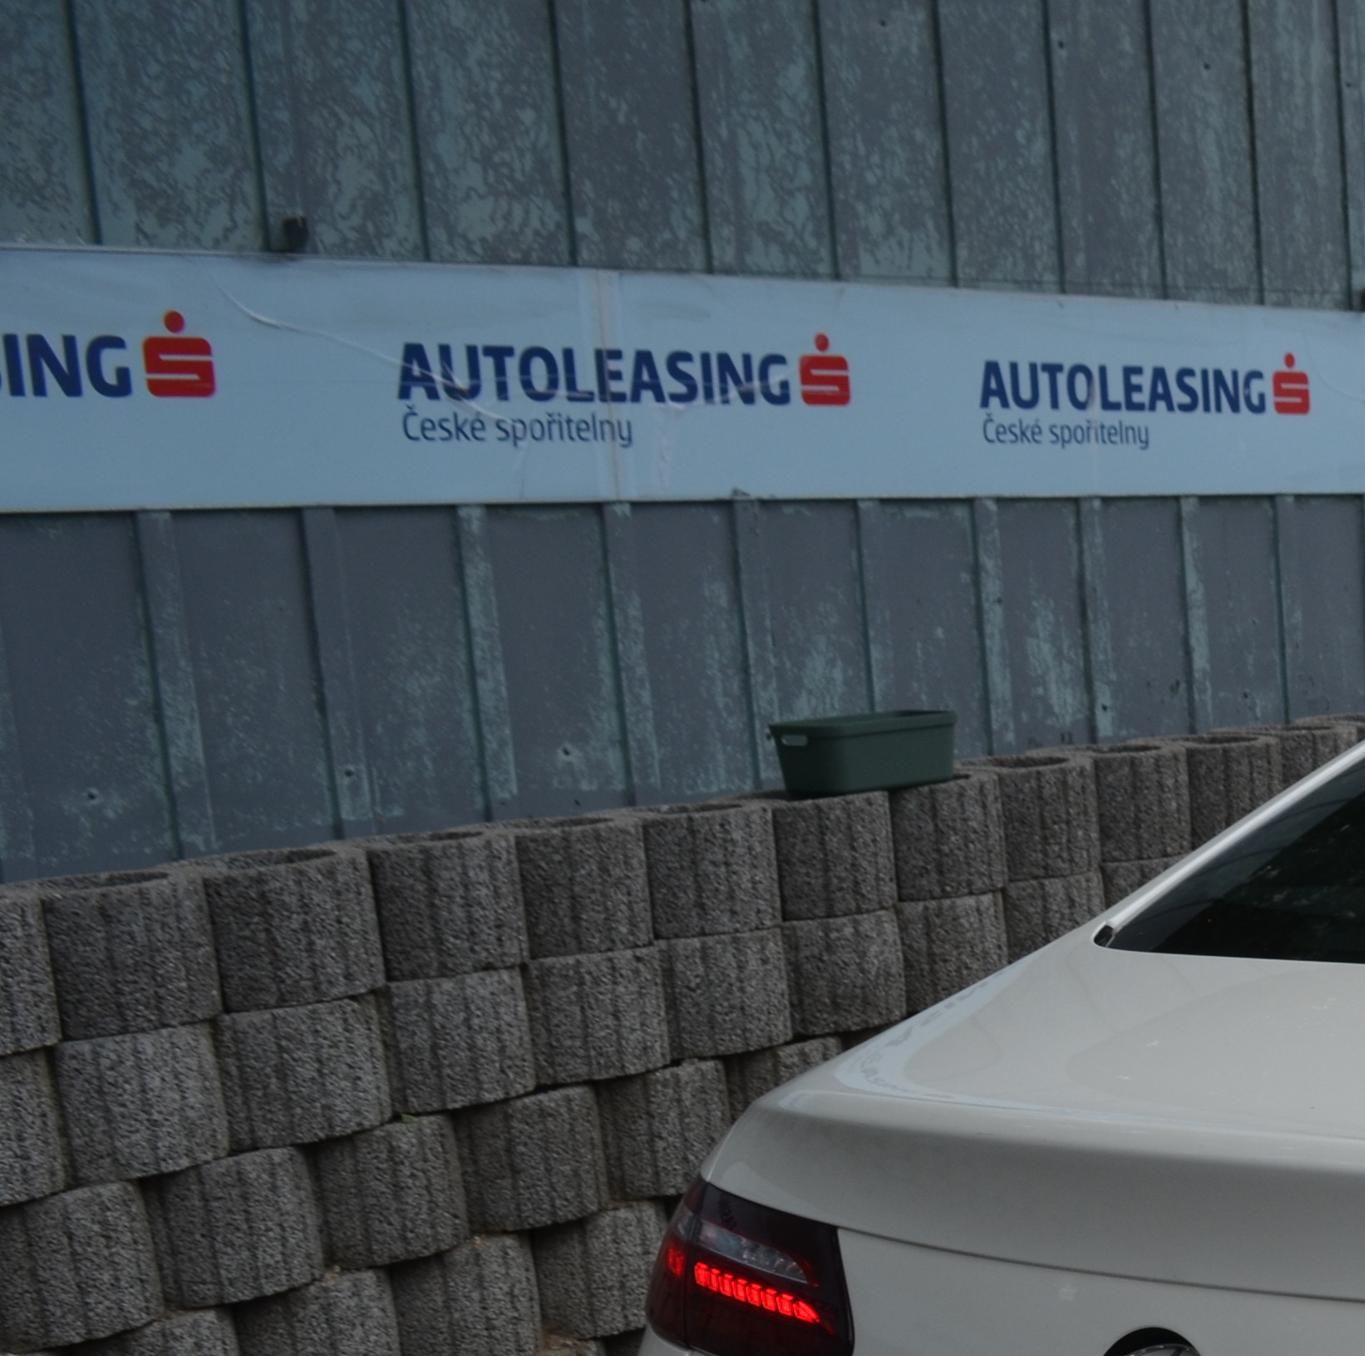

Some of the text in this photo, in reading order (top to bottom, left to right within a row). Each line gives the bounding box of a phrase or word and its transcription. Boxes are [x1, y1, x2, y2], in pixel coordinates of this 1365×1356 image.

[0, 333, 133, 398] ING
[397, 342, 791, 406] AUTOLEASING
[979, 360, 1266, 415] AUTOLEASING
[402, 404, 633, 449] České spořitelny
[983, 412, 1150, 450] České spořitelny
